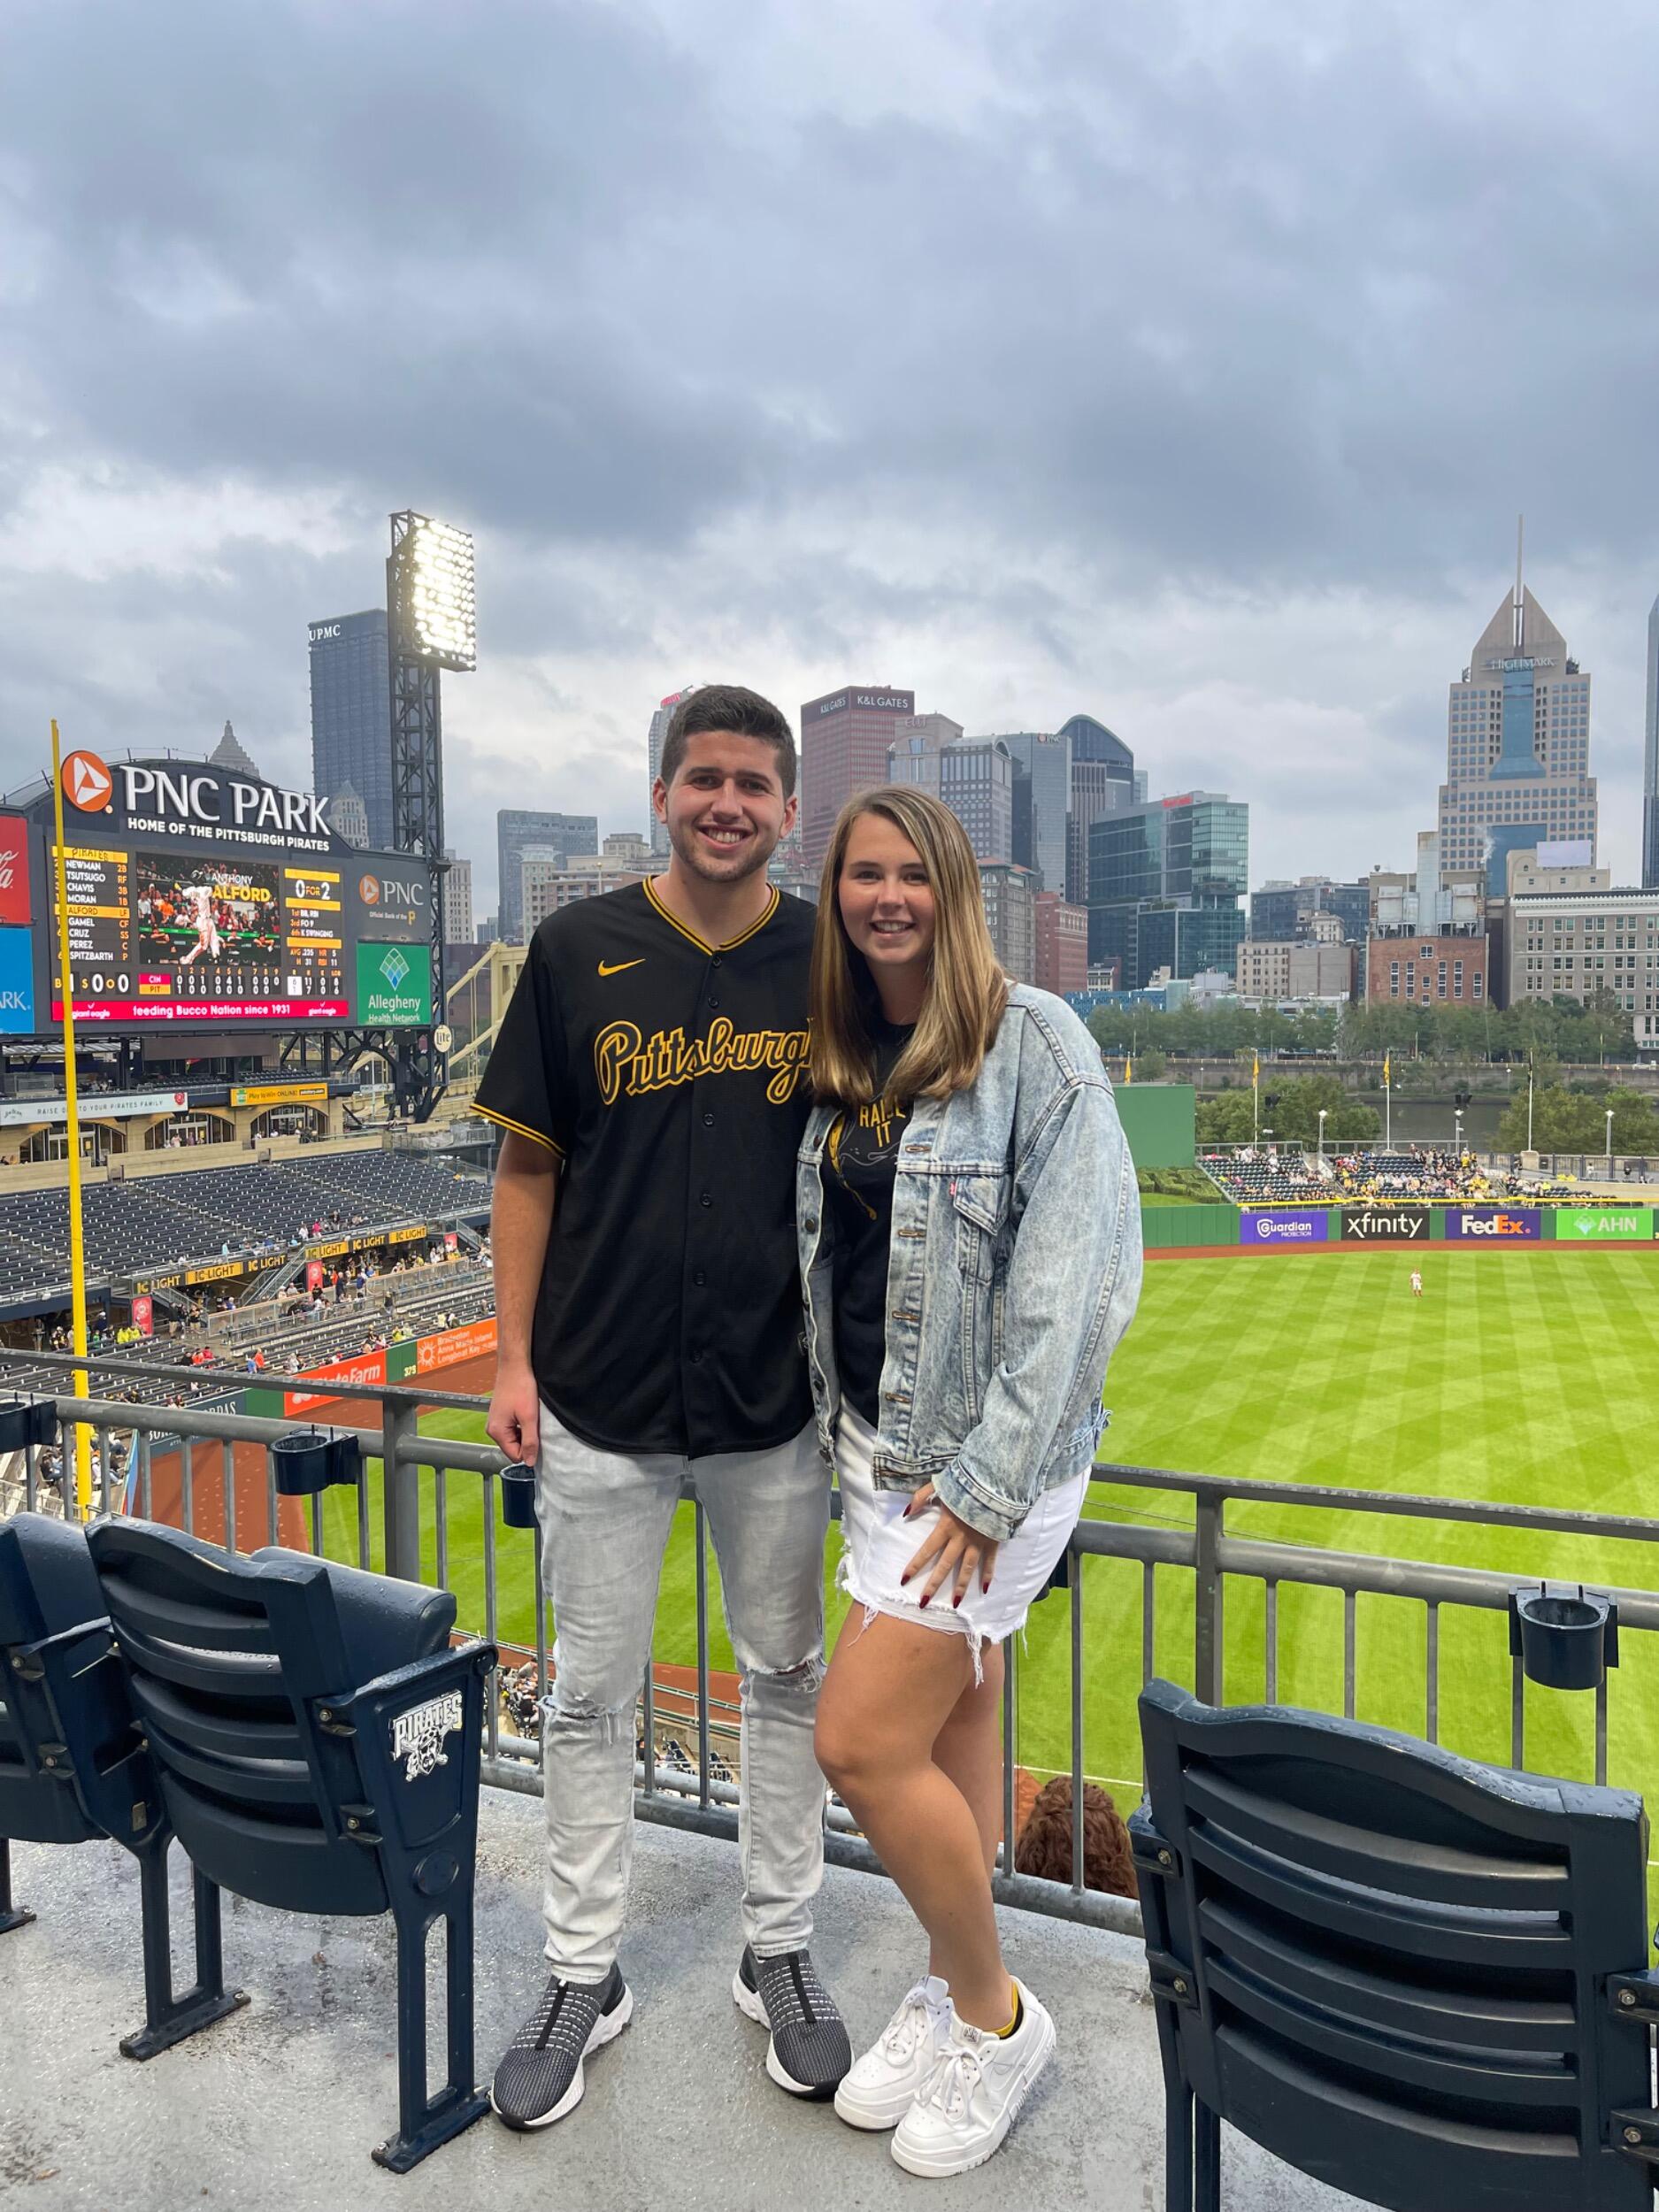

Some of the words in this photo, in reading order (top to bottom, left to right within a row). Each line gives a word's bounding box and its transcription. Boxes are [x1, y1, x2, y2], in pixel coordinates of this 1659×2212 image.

[309, 625, 341, 641] UPMC
[857, 695, 875, 706] K&L
[877, 697, 908, 709] GATES
[119, 765, 219, 821] PNC
[228, 782, 331, 836] PARK
[127, 818, 165, 833] HOME
[170, 821, 186, 834] OF
[189, 825, 212, 838] THE
[216, 827, 285, 847] PITTSBURGH
[287, 836, 330, 851] PIRATES
[72, 849, 108, 861] PIRATES
[65, 860, 101, 871] NEWMAN
[66, 872, 105, 882] TSUTSUGO
[211, 874, 253, 885] ANTHONY
[67, 883, 95, 893] CHAVIS
[212, 886, 271, 902] ALFORD
[296, 879, 305, 898] 0
[305, 886, 320, 896] FOR
[321, 882, 331, 900] 2
[382, 880, 424, 906] PNC
[67, 895, 96, 903] MORAN
[68, 906, 98, 915] ALFORD
[69, 918, 95, 926] GAMEL
[69, 929, 89, 938] CRUZ
[69, 941, 93, 949] PEREZ
[70, 951, 113, 961] SPITZBARTH
[54, 978, 62, 988] B
[81, 978, 88, 989] S
[91, 973, 104, 993] 0
[118, 973, 129, 993] 0
[368, 995, 421, 1011] Allegheny
[133, 1005, 173, 1018] feeding
[177, 1005, 208, 1016] Bucco
[211, 1004, 242, 1015] Nation
[244, 1004, 268, 1014] since
[272, 1004, 290, 1014] 1931
[369, 1014, 391, 1023] Health
[392, 1013, 420, 1024] Network
[436, 1032, 451, 1045] Lite
[876, 1120, 891, 1148] IT
[1261, 1222, 1311, 1233] Guardian
[1348, 1212, 1423, 1239] xfinity
[1462, 1215, 1524, 1234] FedEx
[1598, 1217, 1636, 1232] AHN
[406, 1227, 426, 1239] LIGHT
[354, 1239, 361, 1249] IC
[365, 1235, 385, 1248] LIGHT
[319, 1243, 342, 1256] LIGHT
[248, 1260, 258, 1271] IC
[260, 1255, 286, 1268] LIGHT
[195, 1271, 205, 1282] IC
[208, 1265, 234, 1279] LIGHT
[137, 1282, 149, 1294] IC
[151, 1275, 180, 1289] LIGHT
[394, 1691, 463, 1759] PIRATES
